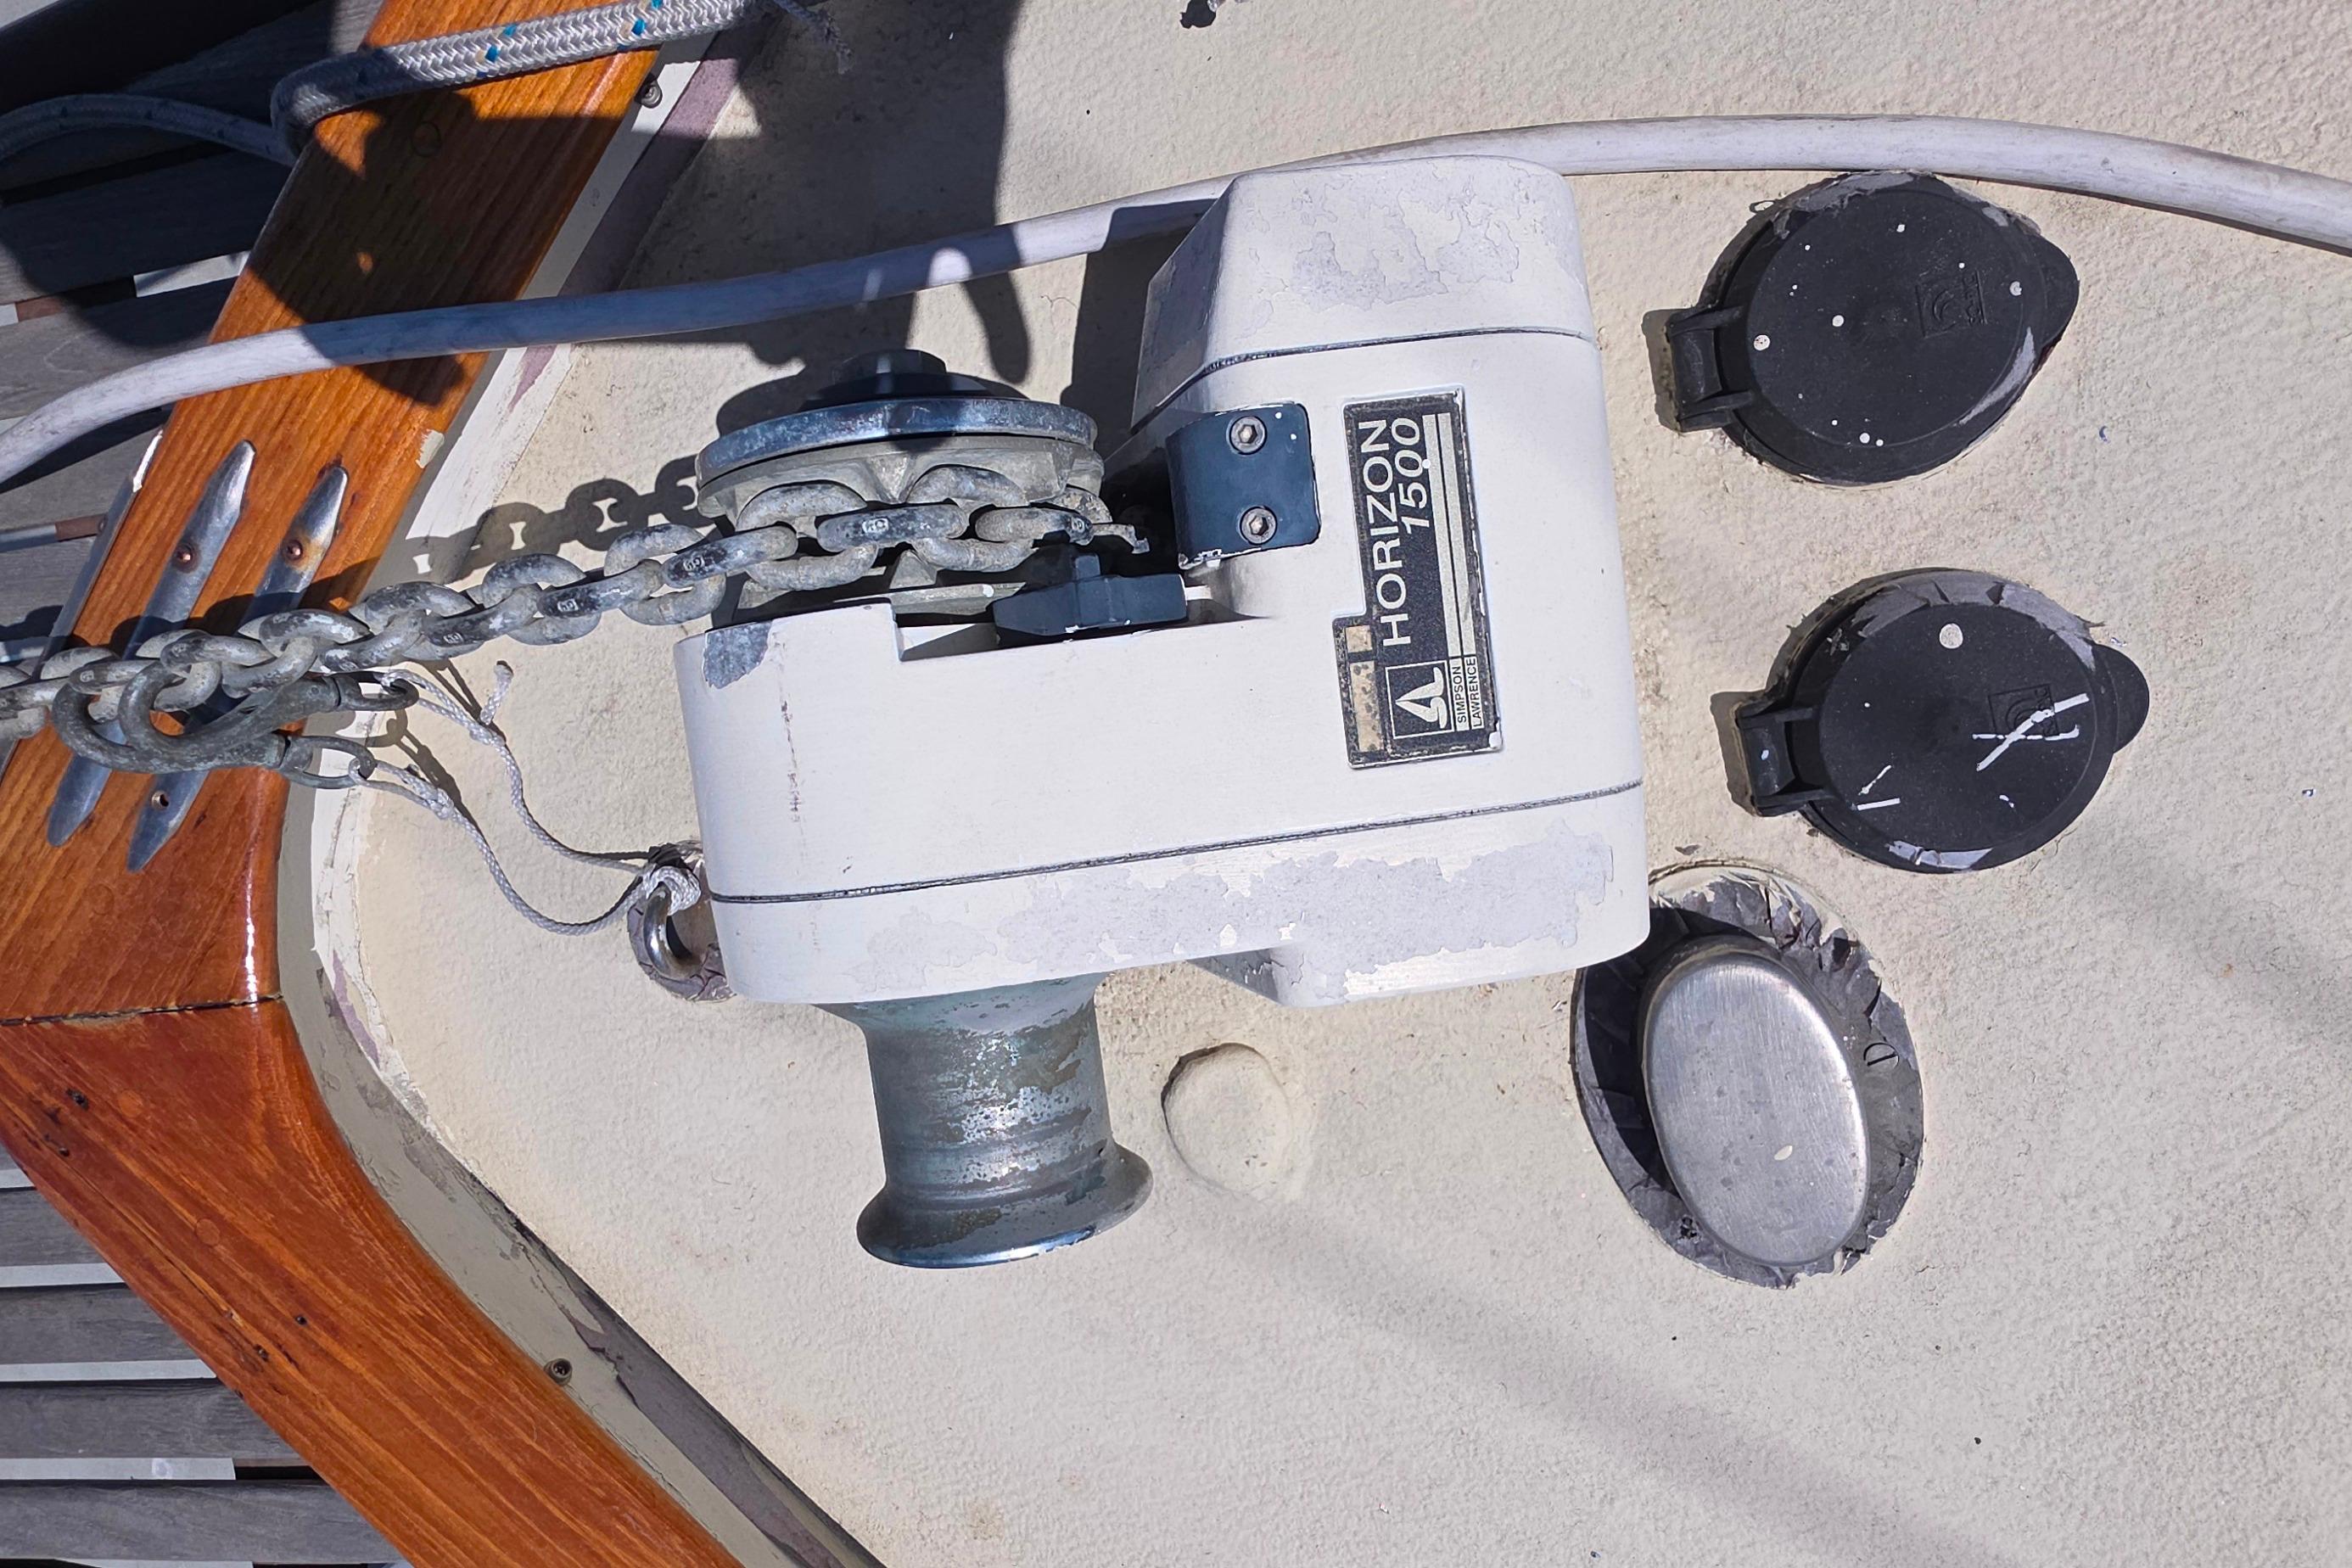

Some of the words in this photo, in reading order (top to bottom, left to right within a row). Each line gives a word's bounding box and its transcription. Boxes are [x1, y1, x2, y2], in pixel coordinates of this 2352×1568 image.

[1392, 417, 1430, 535] 1500
[1358, 419, 1411, 647] HORIZON
[1452, 666, 1467, 724] SIMPSON
[1466, 658, 1483, 728] LAWRENCE
